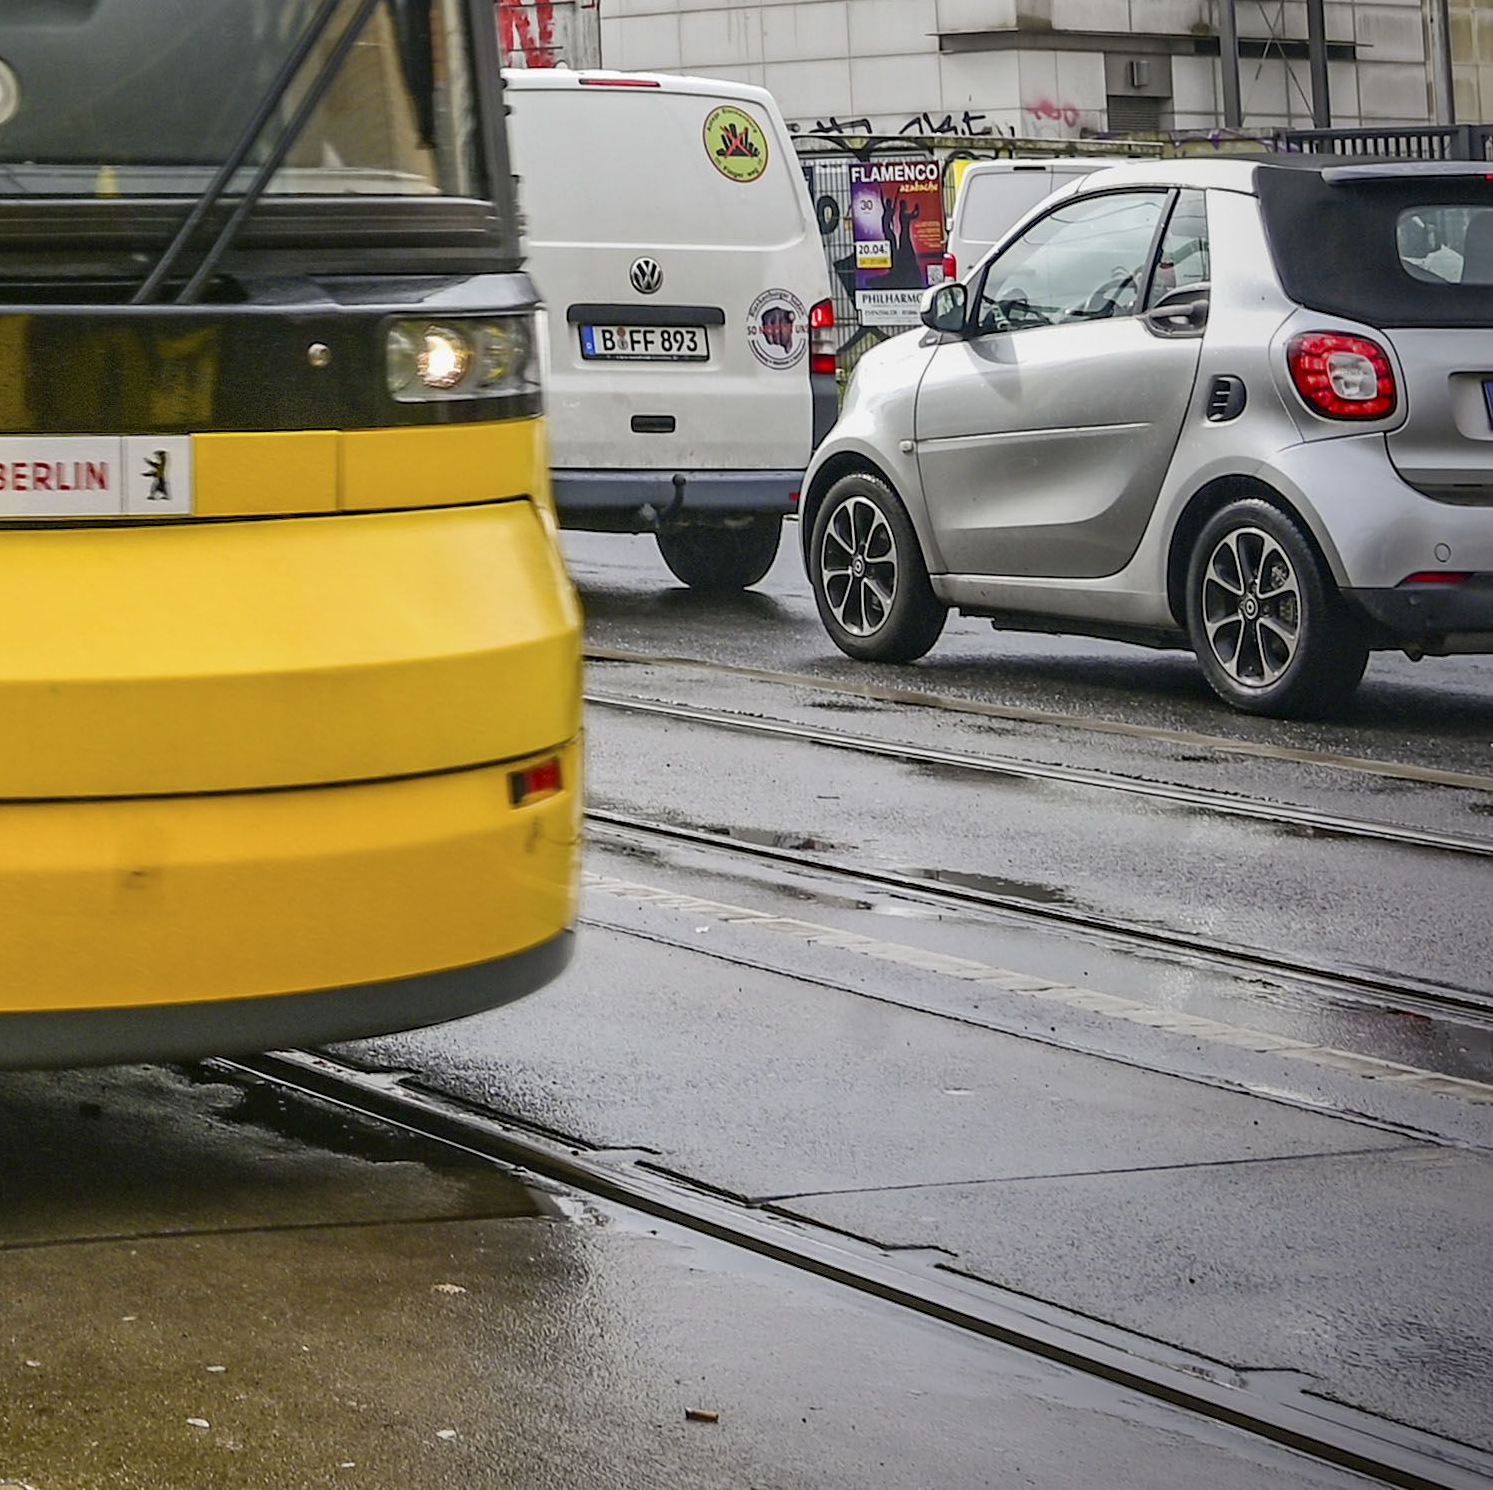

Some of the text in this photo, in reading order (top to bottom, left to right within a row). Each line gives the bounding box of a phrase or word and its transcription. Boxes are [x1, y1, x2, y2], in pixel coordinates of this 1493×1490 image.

[851, 164, 938, 183] FLAMENCO
[860, 199, 874, 211] 30
[601, 329, 616, 351] B
[629, 330, 655, 352] FF
[660, 330, 698, 352] 893
